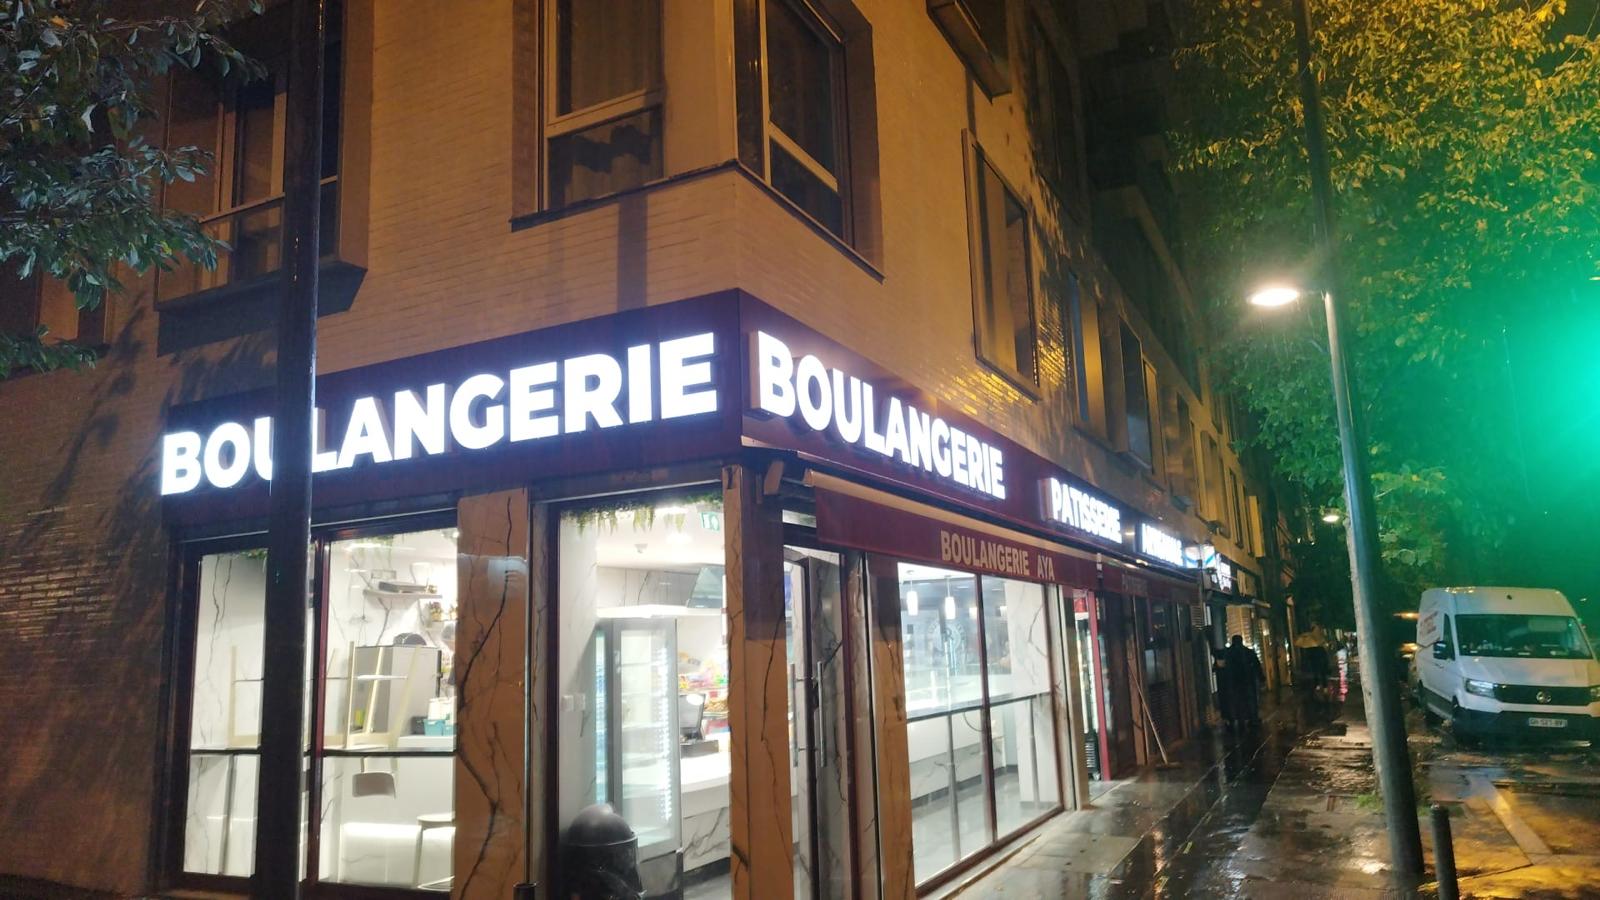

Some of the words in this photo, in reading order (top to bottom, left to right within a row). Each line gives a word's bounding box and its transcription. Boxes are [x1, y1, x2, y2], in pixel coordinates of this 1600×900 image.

[757, 330, 1006, 500] BOULANGERIE
[940, 529, 1031, 576] BOULANGERIE
[1037, 554, 1056, 581] AYA
